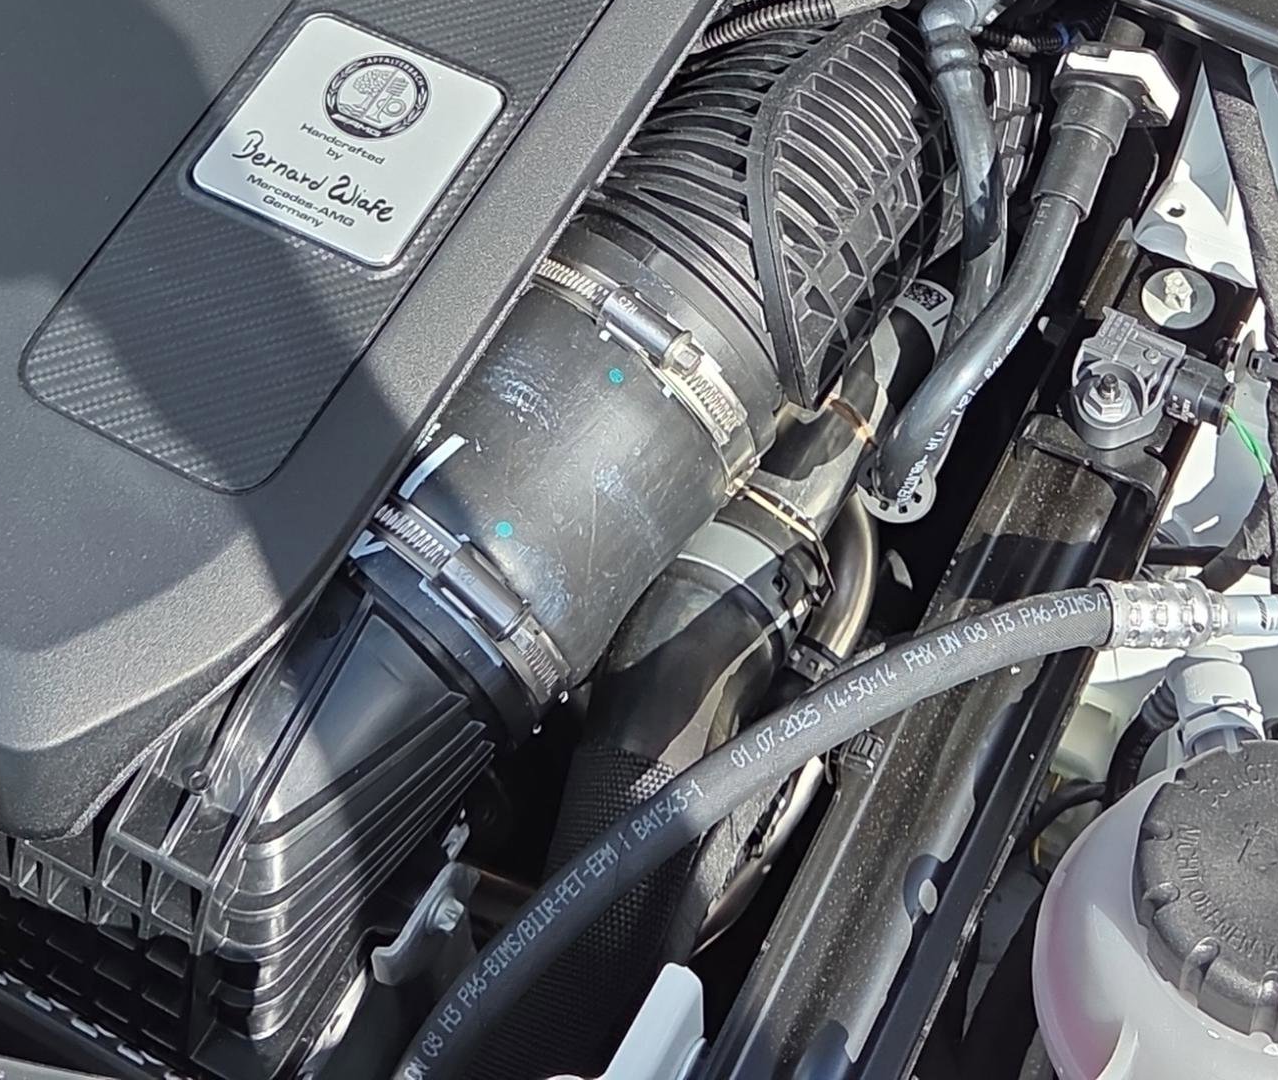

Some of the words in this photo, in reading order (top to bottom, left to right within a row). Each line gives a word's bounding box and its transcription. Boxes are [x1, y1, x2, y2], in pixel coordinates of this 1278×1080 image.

[364, 54, 427, 89] AFFALTERBACH
[232, 129, 326, 191] Bernard
[300, 122, 385, 165] Handcrafted
[326, 148, 343, 161] by
[246, 173, 355, 227] Mercedes-AMG
[262, 194, 324, 229] Germany
[730, 701, 822, 769] 01.07.2025
[823, 667, 898, 715] 14:50:14
[940, 633, 963, 658] DN
[964, 622, 988, 643] 08
[993, 614, 1017, 638] H3
[422, 1031, 444, 1057] 08
[437, 1006, 463, 1033] H3
[630, 778, 706, 841] BA1543-1
